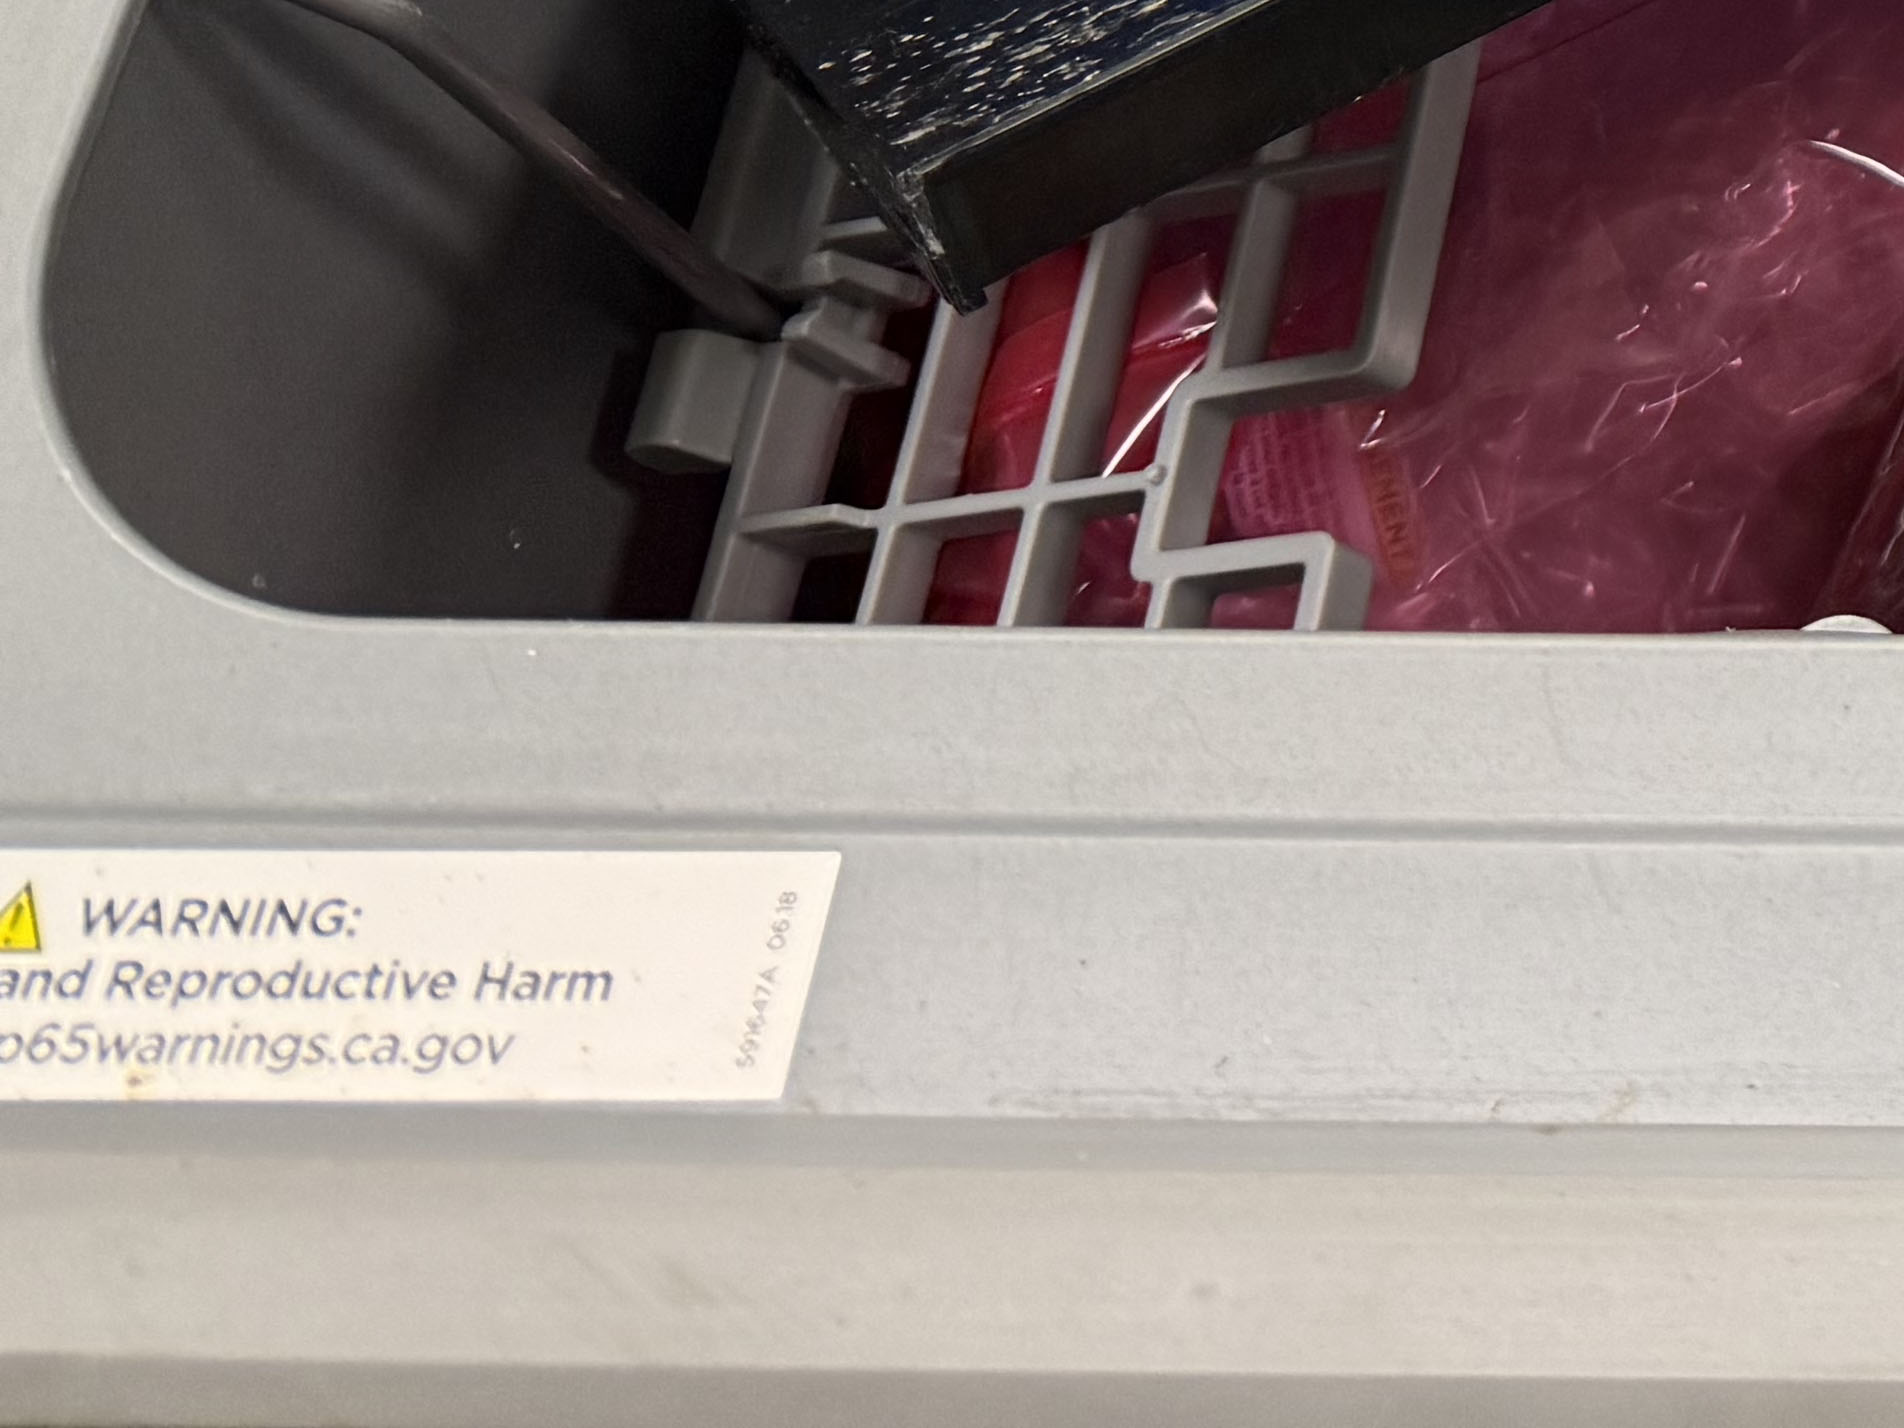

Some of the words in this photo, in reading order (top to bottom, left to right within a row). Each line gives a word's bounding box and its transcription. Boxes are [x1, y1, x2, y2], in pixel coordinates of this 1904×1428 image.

[82, 897, 362, 938] WARNING:
[0, 958, 94, 1001] and
[106, 957, 458, 1009] Reproductive
[474, 960, 614, 1002] Harm
